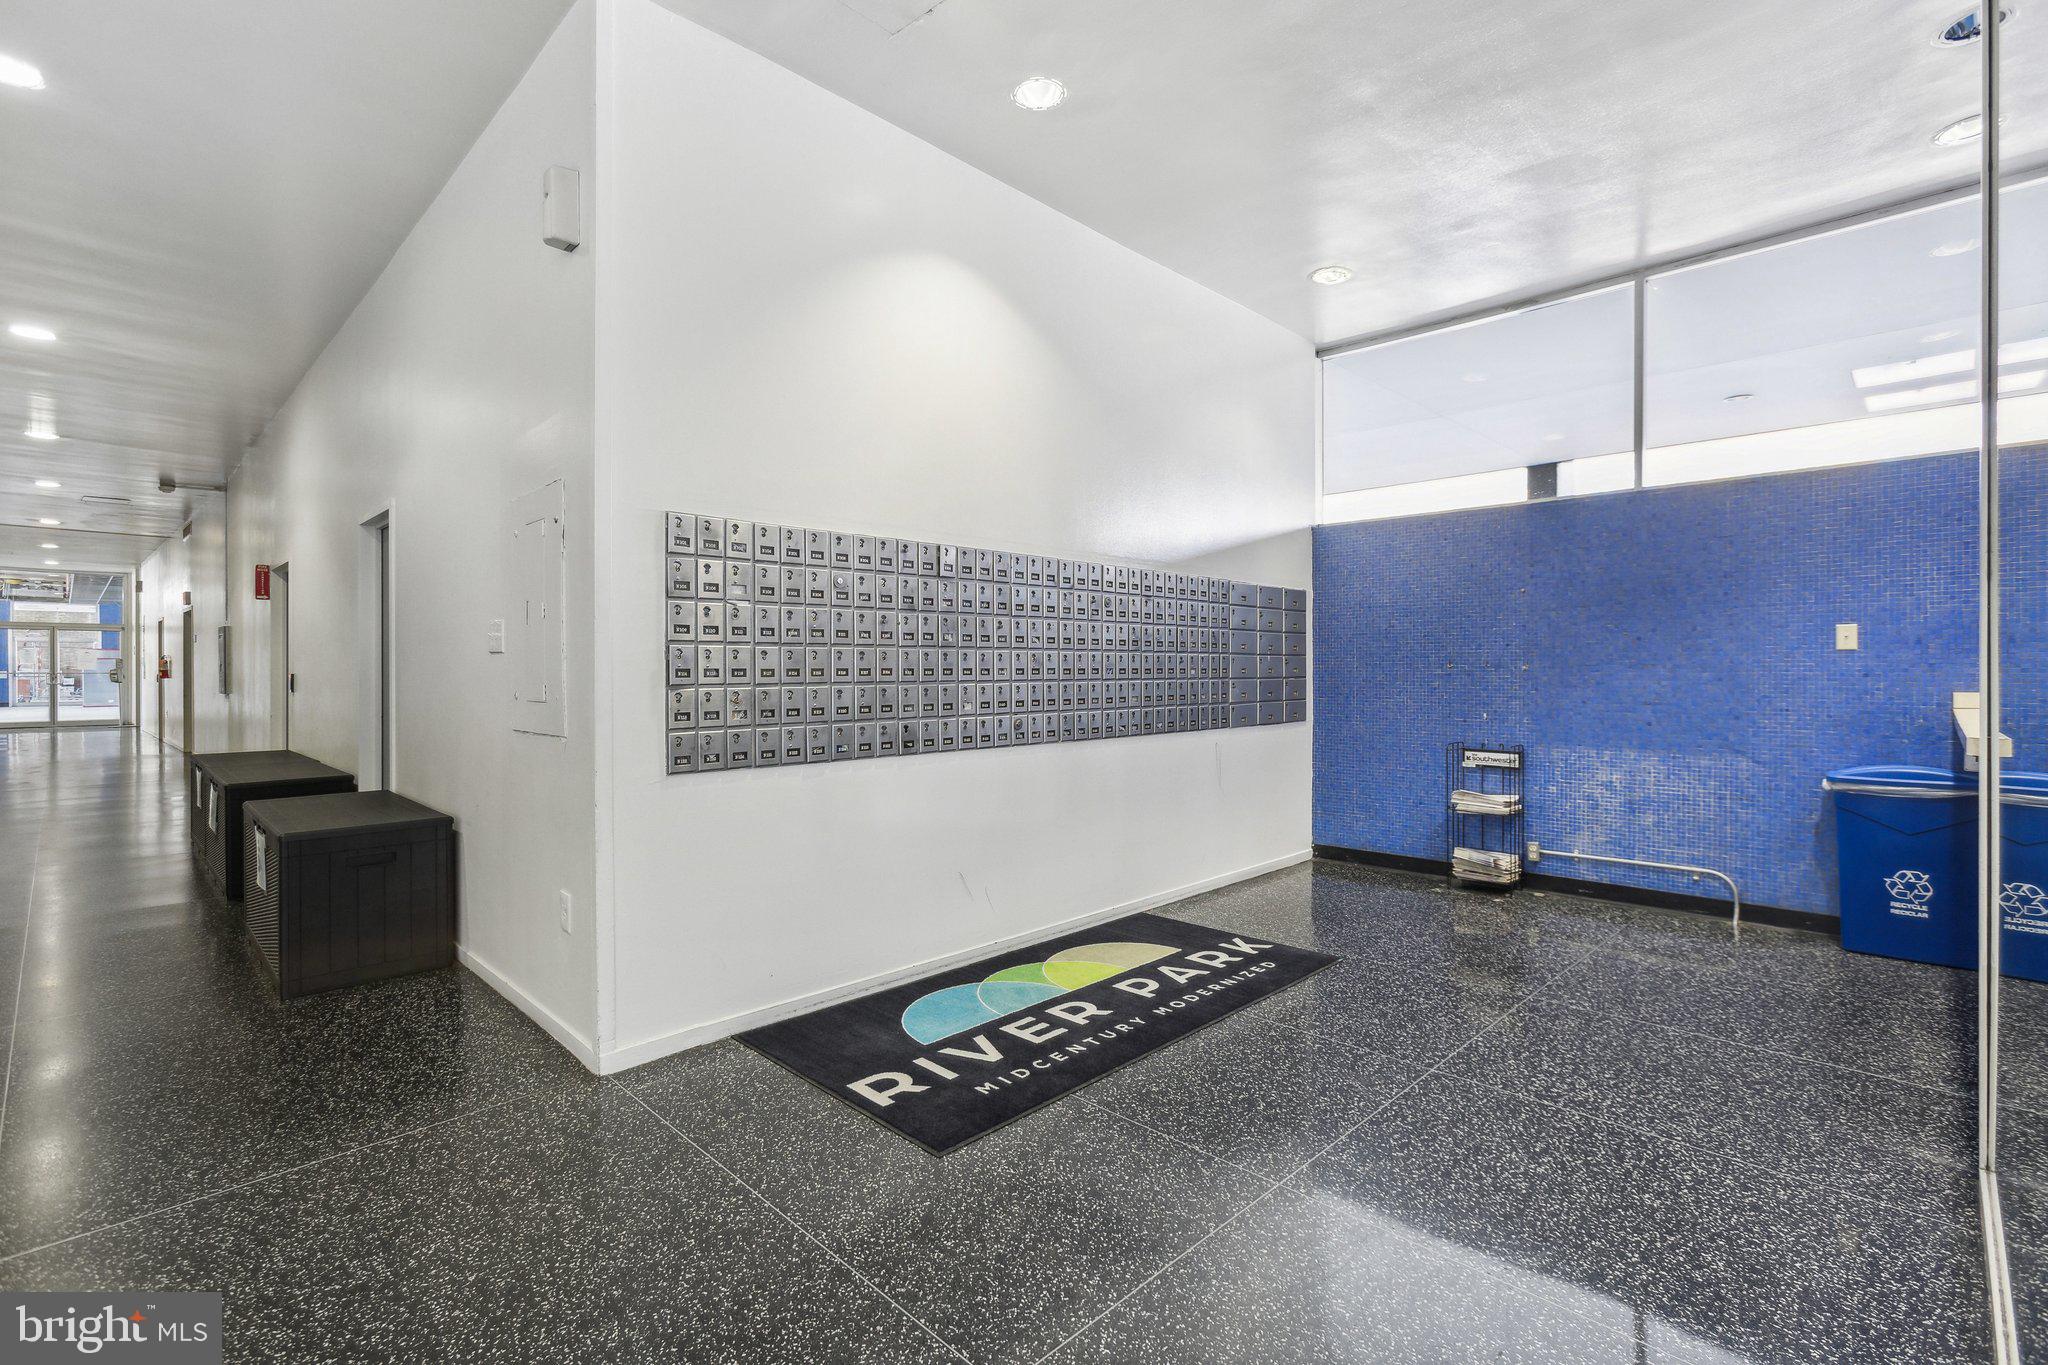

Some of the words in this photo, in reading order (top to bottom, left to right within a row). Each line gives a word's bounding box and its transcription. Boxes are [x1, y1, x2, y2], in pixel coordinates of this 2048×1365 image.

[1889, 901, 1928, 911] RECYCLE
[846, 999, 1114, 1107] RIVER
[1112, 937, 1275, 999] PARK
[974, 1016, 1147, 1095] MIDCENTURY
[1157, 960, 1277, 1016] MODERNIZED
